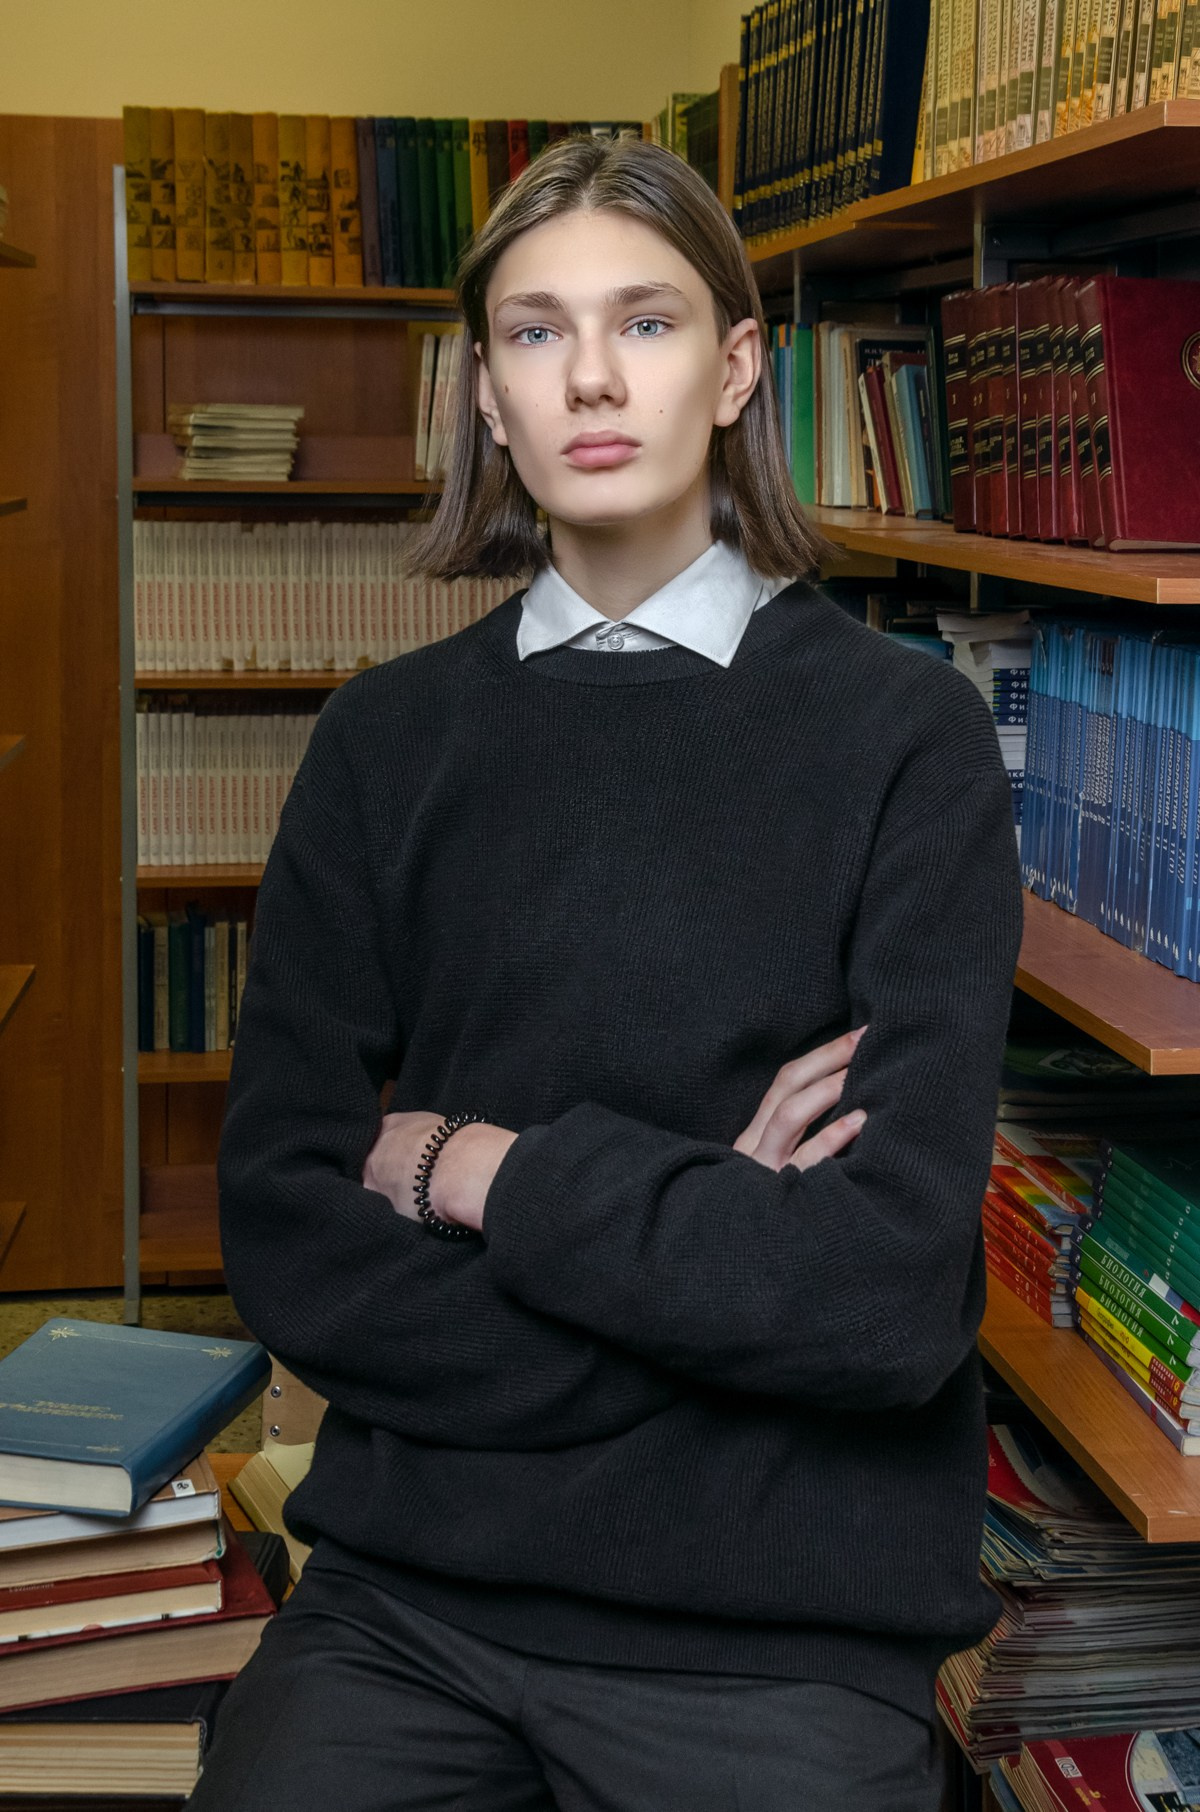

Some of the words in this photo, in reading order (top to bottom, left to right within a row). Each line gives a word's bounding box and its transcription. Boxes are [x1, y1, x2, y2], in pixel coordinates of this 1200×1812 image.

[1098, 1274, 1143, 1319] БИОЛОГИЯ
[1100, 1254, 1147, 1299] БИОЛОГИЯ
[1100, 1292, 1144, 1338] БИОЛОГИЯ
